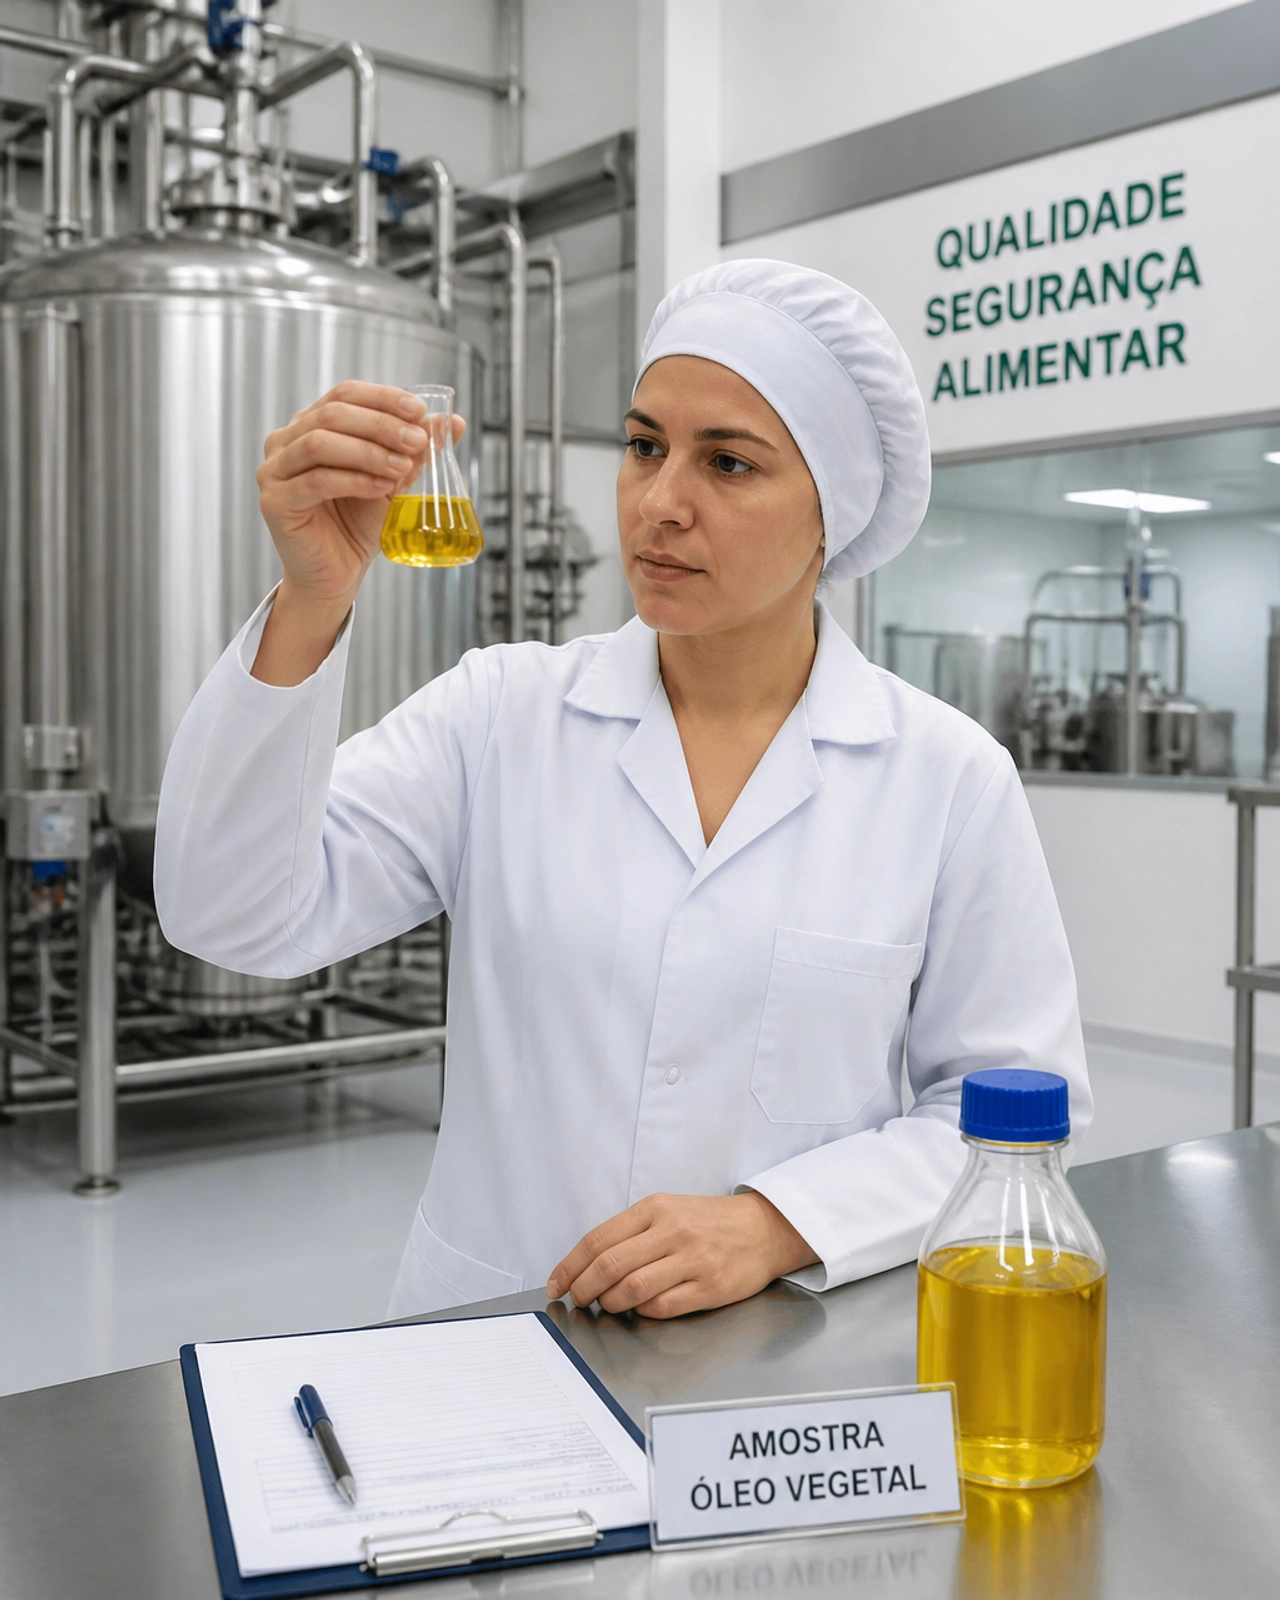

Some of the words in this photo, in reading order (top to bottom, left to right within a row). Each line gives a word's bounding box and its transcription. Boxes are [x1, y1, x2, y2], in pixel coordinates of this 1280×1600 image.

[937, 172, 1185, 269] QUALIDADE
[926, 245, 1202, 338] SEGURANÇA
[933, 322, 1187, 401] ALIMENTAR
[729, 1421, 884, 1460] AMOSTRA
[690, 1476, 776, 1510] ÓLEO
[786, 1464, 927, 1502] VEGETAL
